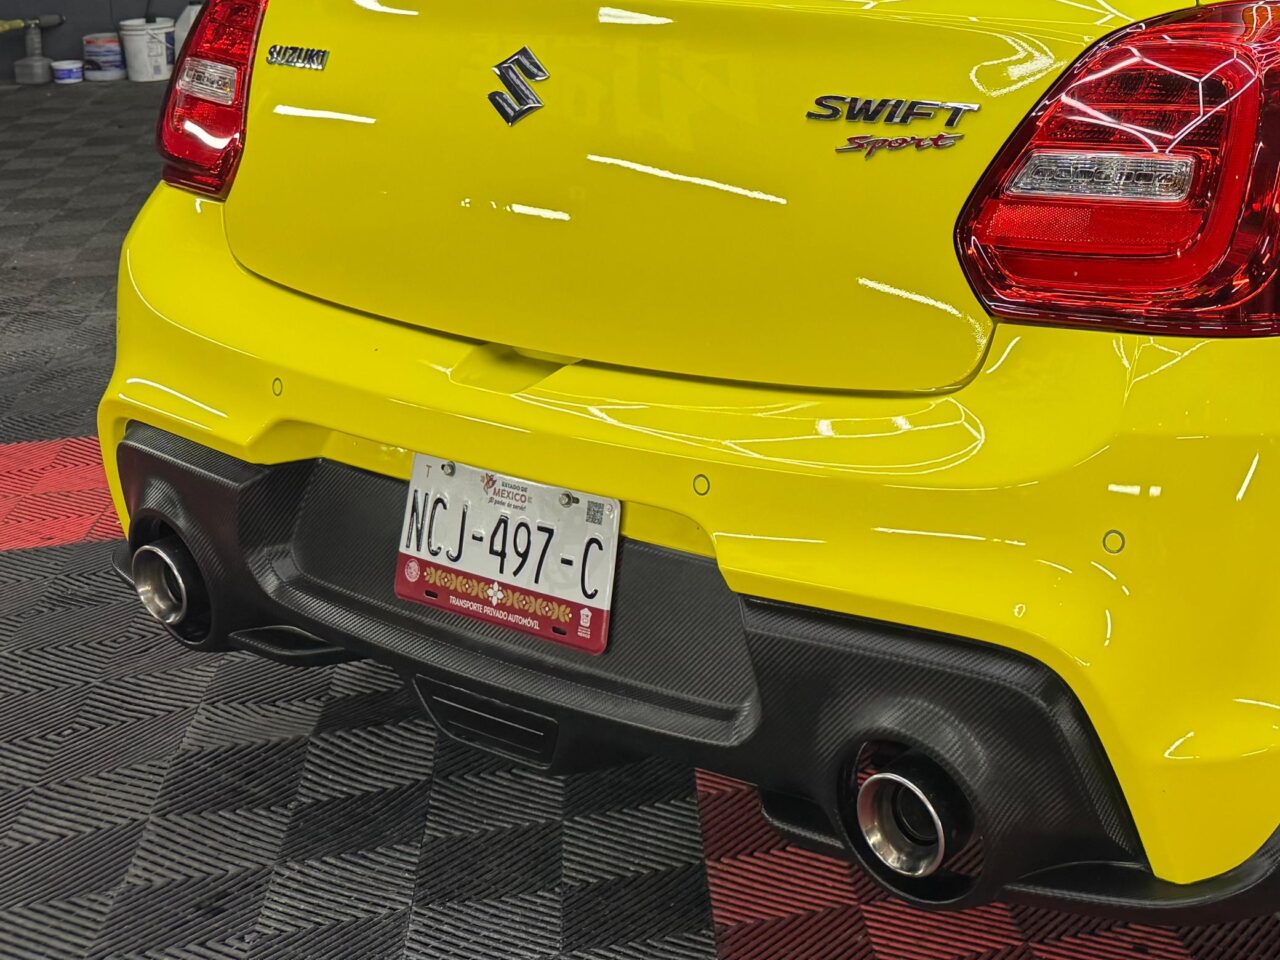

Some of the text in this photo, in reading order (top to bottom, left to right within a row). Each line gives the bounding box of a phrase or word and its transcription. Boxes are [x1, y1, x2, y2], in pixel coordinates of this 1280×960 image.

[266, 44, 330, 71] SUZUKI
[805, 95, 981, 129] SWIFT
[835, 131, 965, 160] Sport
[405, 489, 604, 599] NCJ-497-C
[449, 595, 483, 613] TRANSPORTE
[483, 605, 508, 620] PRIVADO
